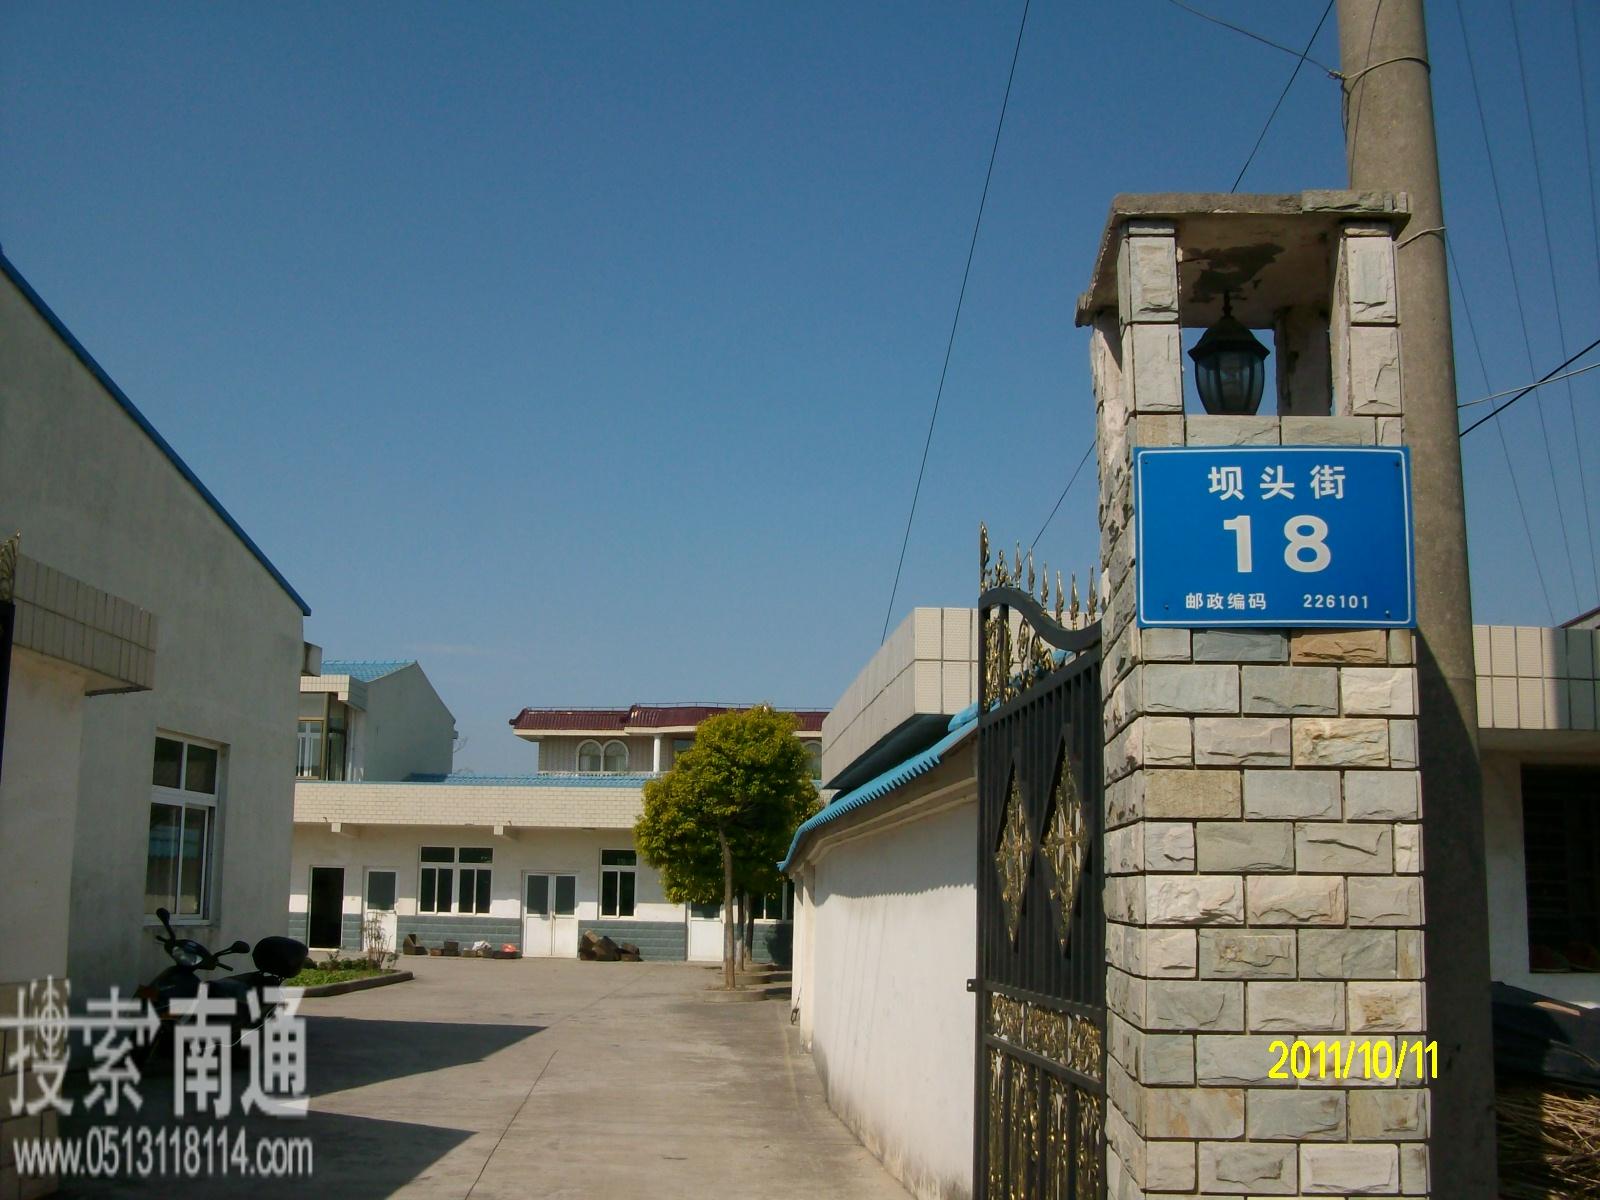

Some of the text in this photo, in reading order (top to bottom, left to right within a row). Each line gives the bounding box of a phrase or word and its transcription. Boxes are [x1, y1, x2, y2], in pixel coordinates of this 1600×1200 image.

[1207, 464, 1346, 501] 坝头街
[1223, 514, 1331, 573] 18
[1185, 592, 1369, 610] 邮政编码 226101
